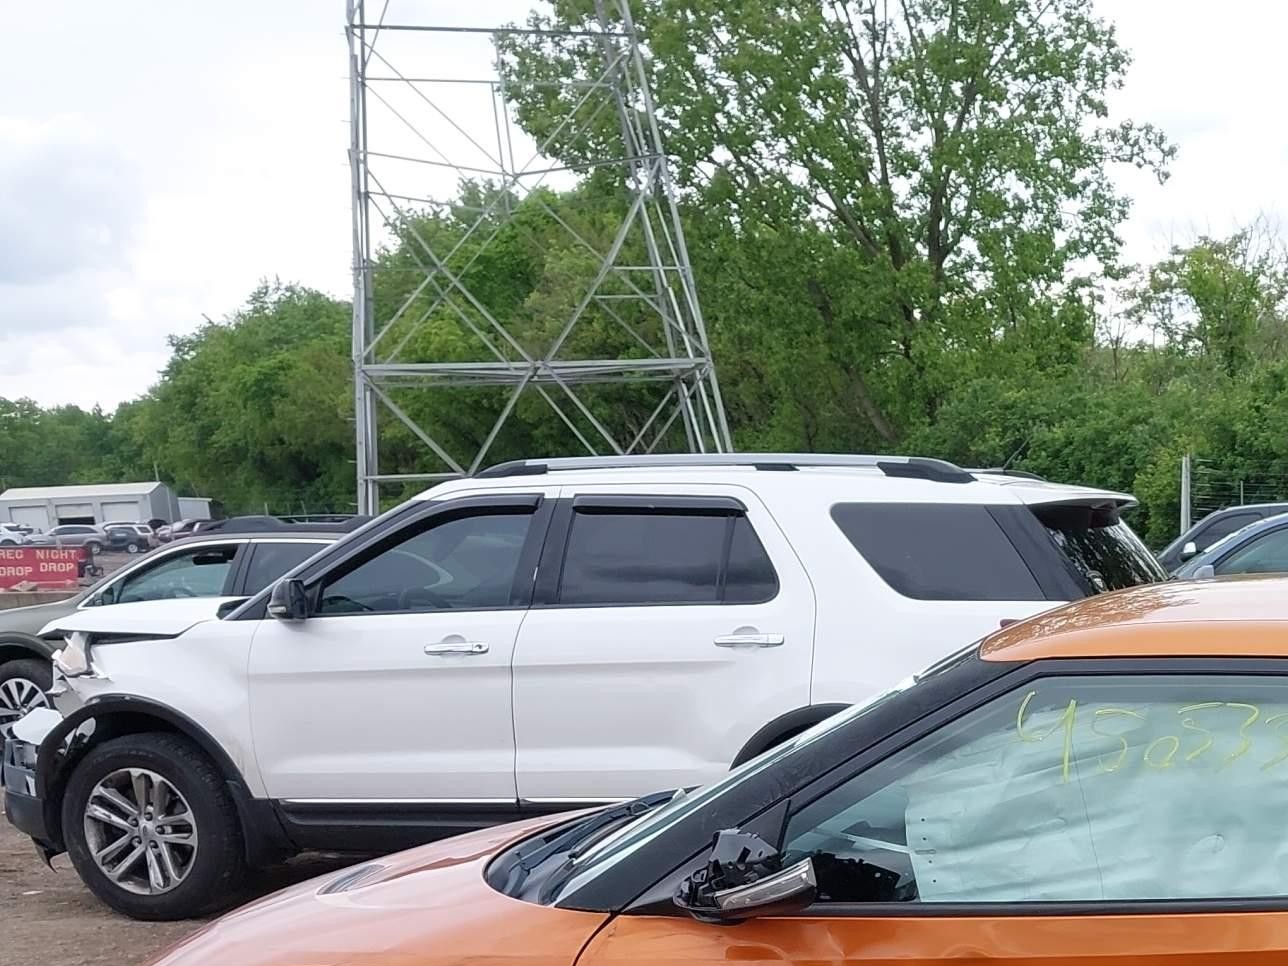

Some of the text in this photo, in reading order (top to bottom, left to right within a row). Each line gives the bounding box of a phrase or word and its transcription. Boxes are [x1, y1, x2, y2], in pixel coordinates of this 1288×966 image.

[36, 549, 76, 560] NIGHT
[0, 566, 33, 576] DROP
[39, 562, 74, 572] DROP
